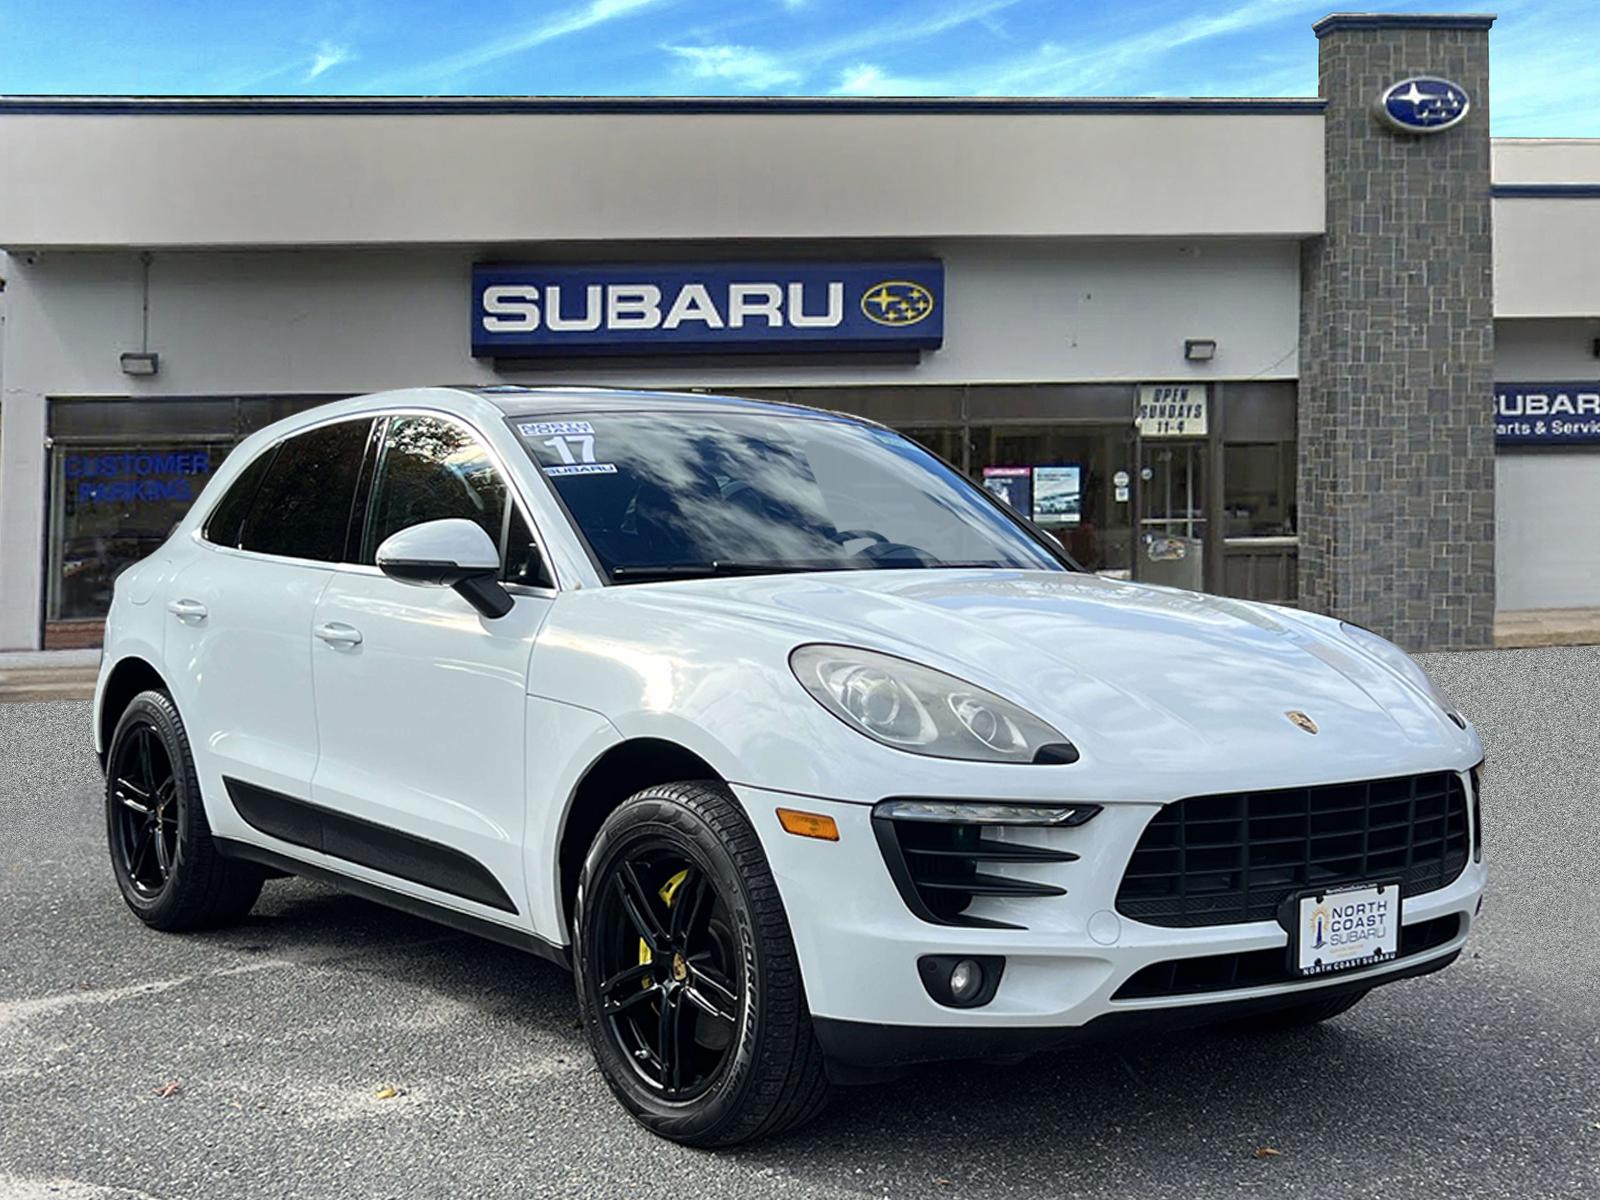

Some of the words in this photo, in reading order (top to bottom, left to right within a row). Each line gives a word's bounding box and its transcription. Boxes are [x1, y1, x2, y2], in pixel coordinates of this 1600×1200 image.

[482, 281, 844, 333] SUBARU
[1153, 388, 1190, 403] OPEN
[1493, 393, 1600, 416] UBAR
[1140, 404, 1203, 419] SUNDAYS
[522, 422, 589, 430] NORTH
[1157, 420, 1185, 433] 11-4
[1496, 421, 1531, 435] arts
[1534, 420, 1547, 435] &
[543, 435, 596, 465] 17
[65, 451, 210, 478] CUSTOMER
[548, 465, 614, 474] SUBARU
[77, 480, 192, 504] PARKING
[1332, 900, 1388, 919] NORTH
[1331, 913, 1387, 933] COAST
[1330, 928, 1386, 945] SUBARU
[1303, 964, 1332, 975] NORTH
[1334, 959, 1360, 970] COAST
[1363, 952, 1395, 964] SUBARU
[736, 908, 758, 1056] SCORPION
